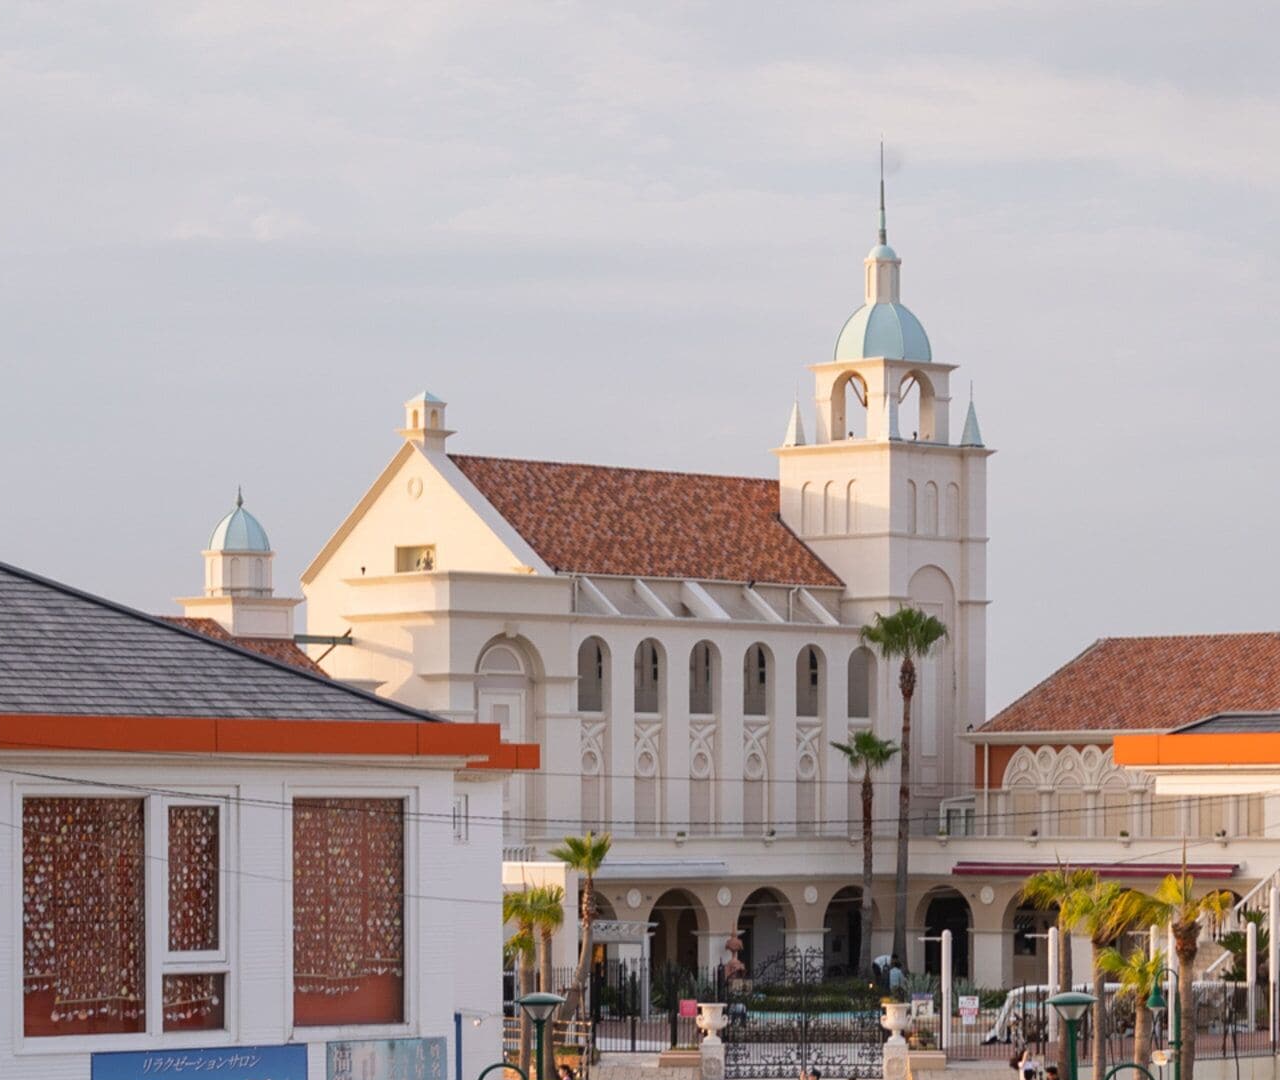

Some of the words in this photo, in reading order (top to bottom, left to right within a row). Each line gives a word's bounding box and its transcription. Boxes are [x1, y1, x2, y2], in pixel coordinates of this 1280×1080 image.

[143, 1054, 261, 1074] リラクゼーションサロン
